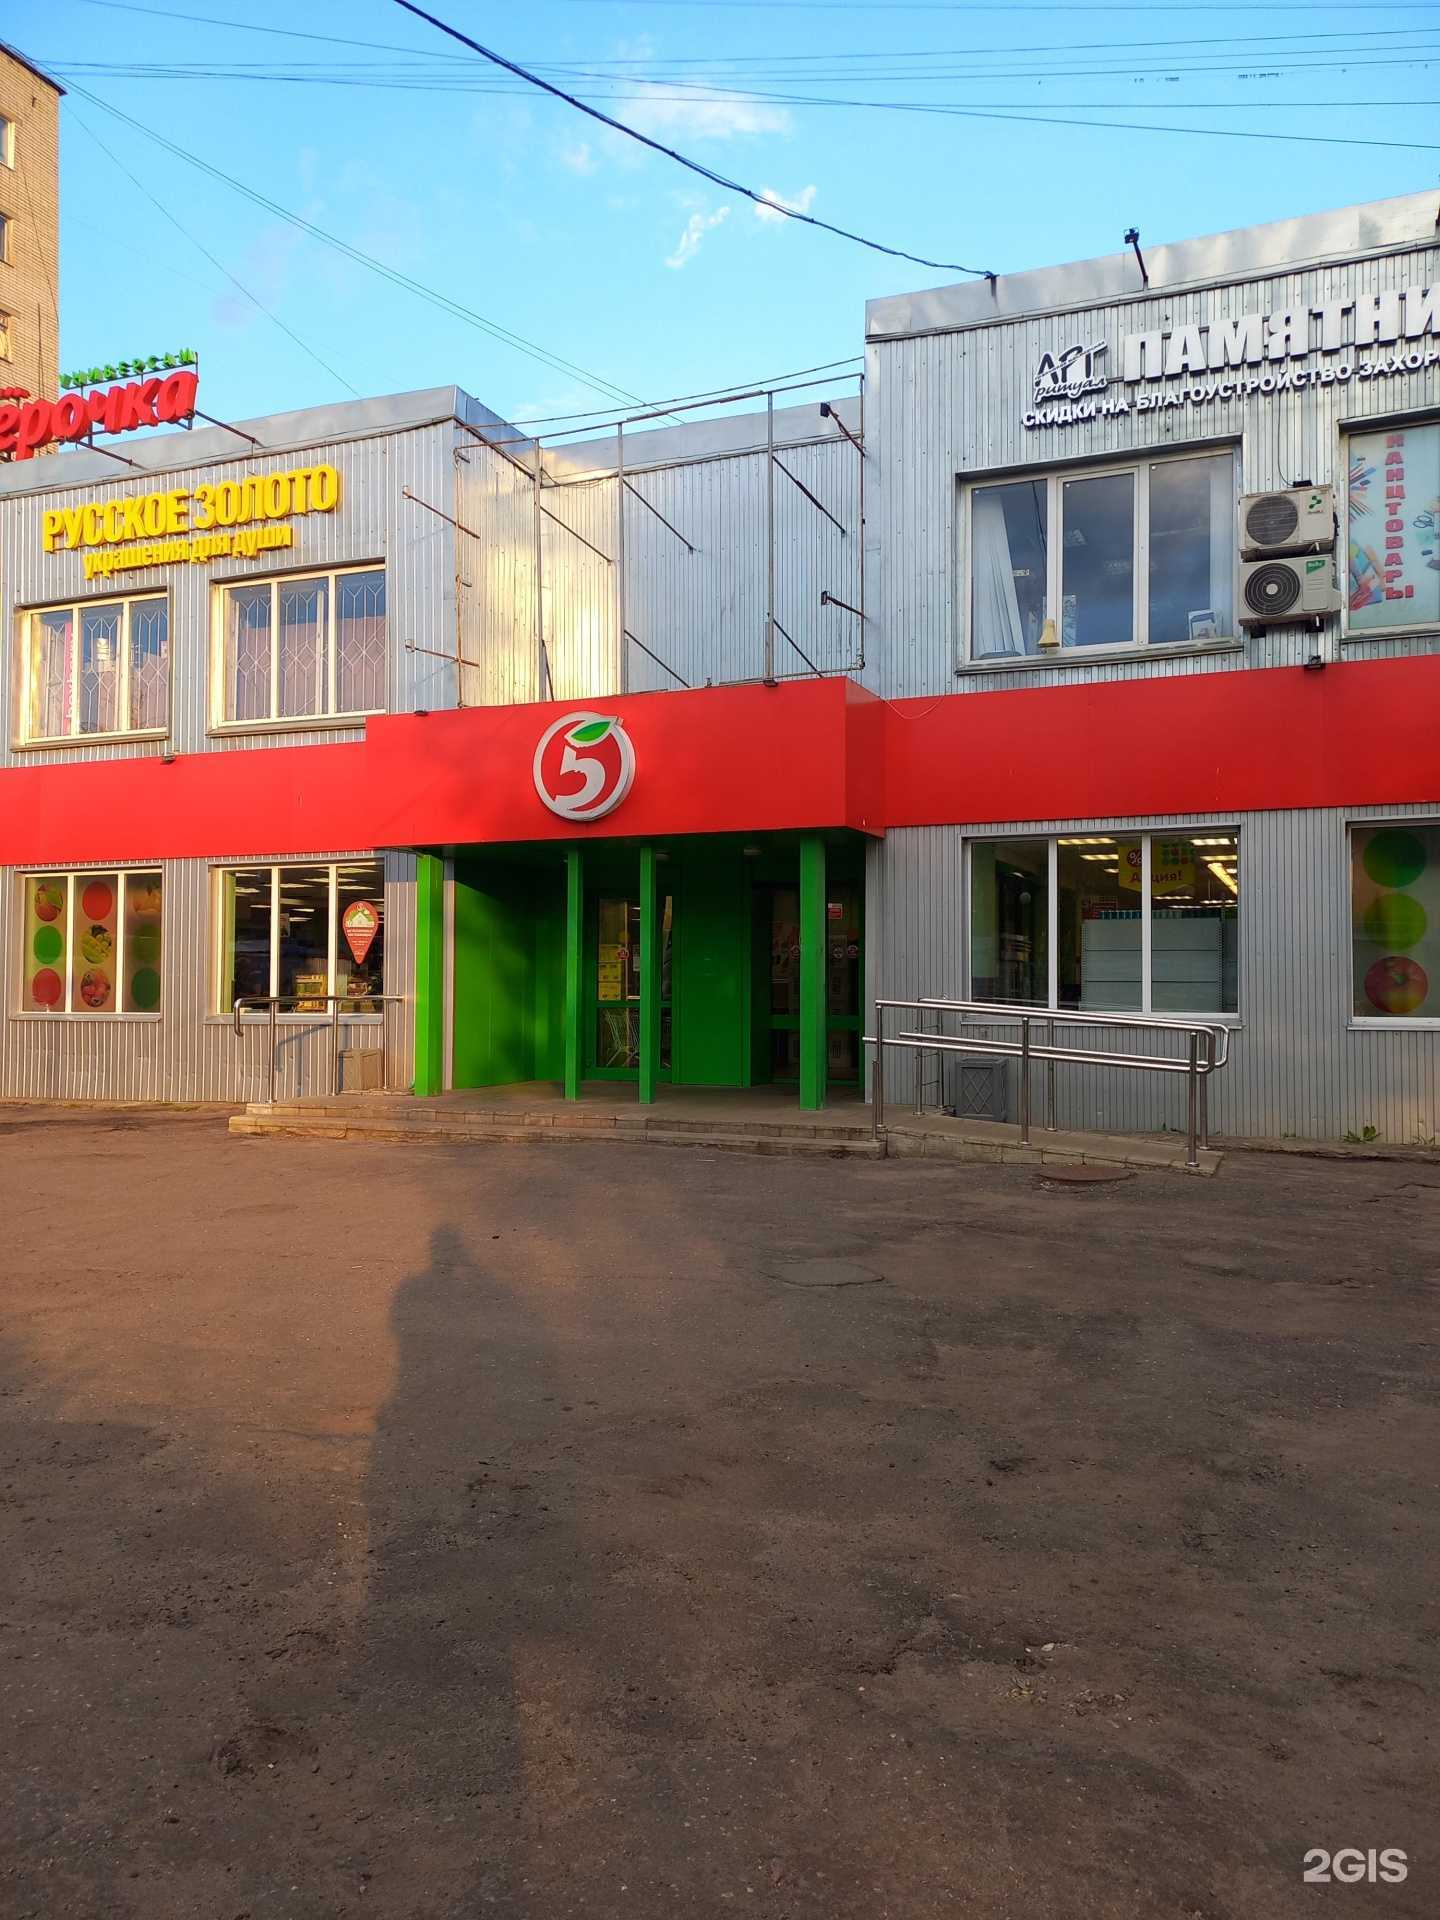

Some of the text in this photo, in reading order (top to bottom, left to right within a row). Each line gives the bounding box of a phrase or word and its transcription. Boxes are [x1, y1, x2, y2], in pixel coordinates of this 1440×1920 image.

[1124, 283, 1440, 382] ПАМЯТНИ
[1022, 350, 1440, 427] СКИДКИ НА БЛАГОУСТРОЙСТВО ЗАХОР
[1034, 341, 1107, 388] АРТ
[1034, 376, 1107, 404] ритуал
[43, 463, 339, 553] РУССКОЕ ЗОЛОТО
[83, 524, 294, 580] украшения для души
[1129, 871, 1184, 884] Ация!
